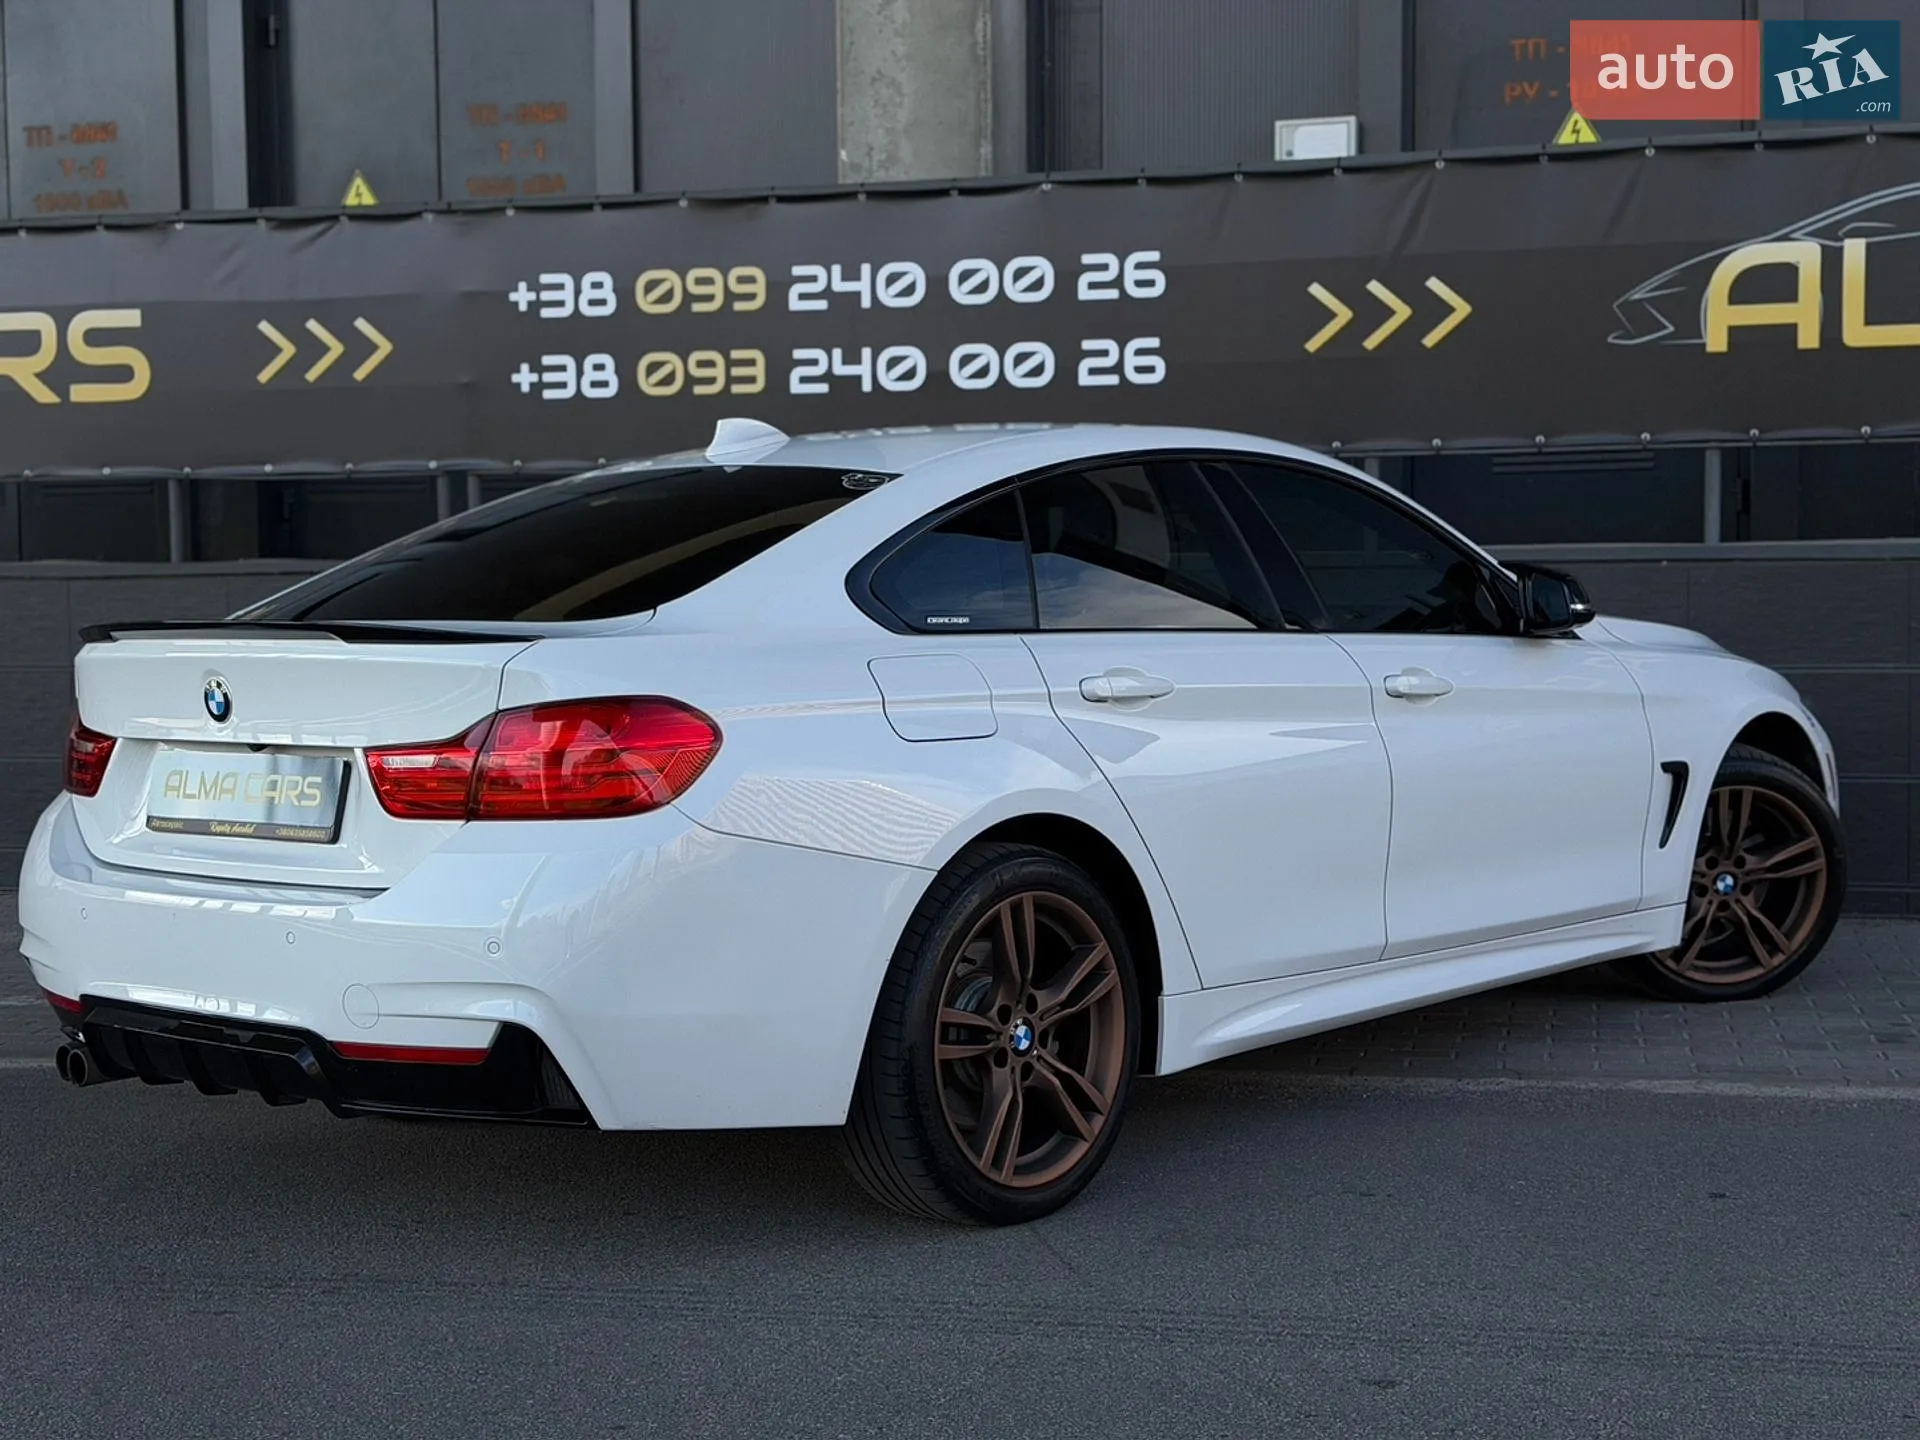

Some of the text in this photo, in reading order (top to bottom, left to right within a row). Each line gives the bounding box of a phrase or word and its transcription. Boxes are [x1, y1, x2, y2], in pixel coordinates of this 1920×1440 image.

[508, 250, 1167, 318] +38 099 240 00 26
[511, 337, 1167, 400] +38 093 240 00 26
[163, 769, 323, 807] ALMA CARS
